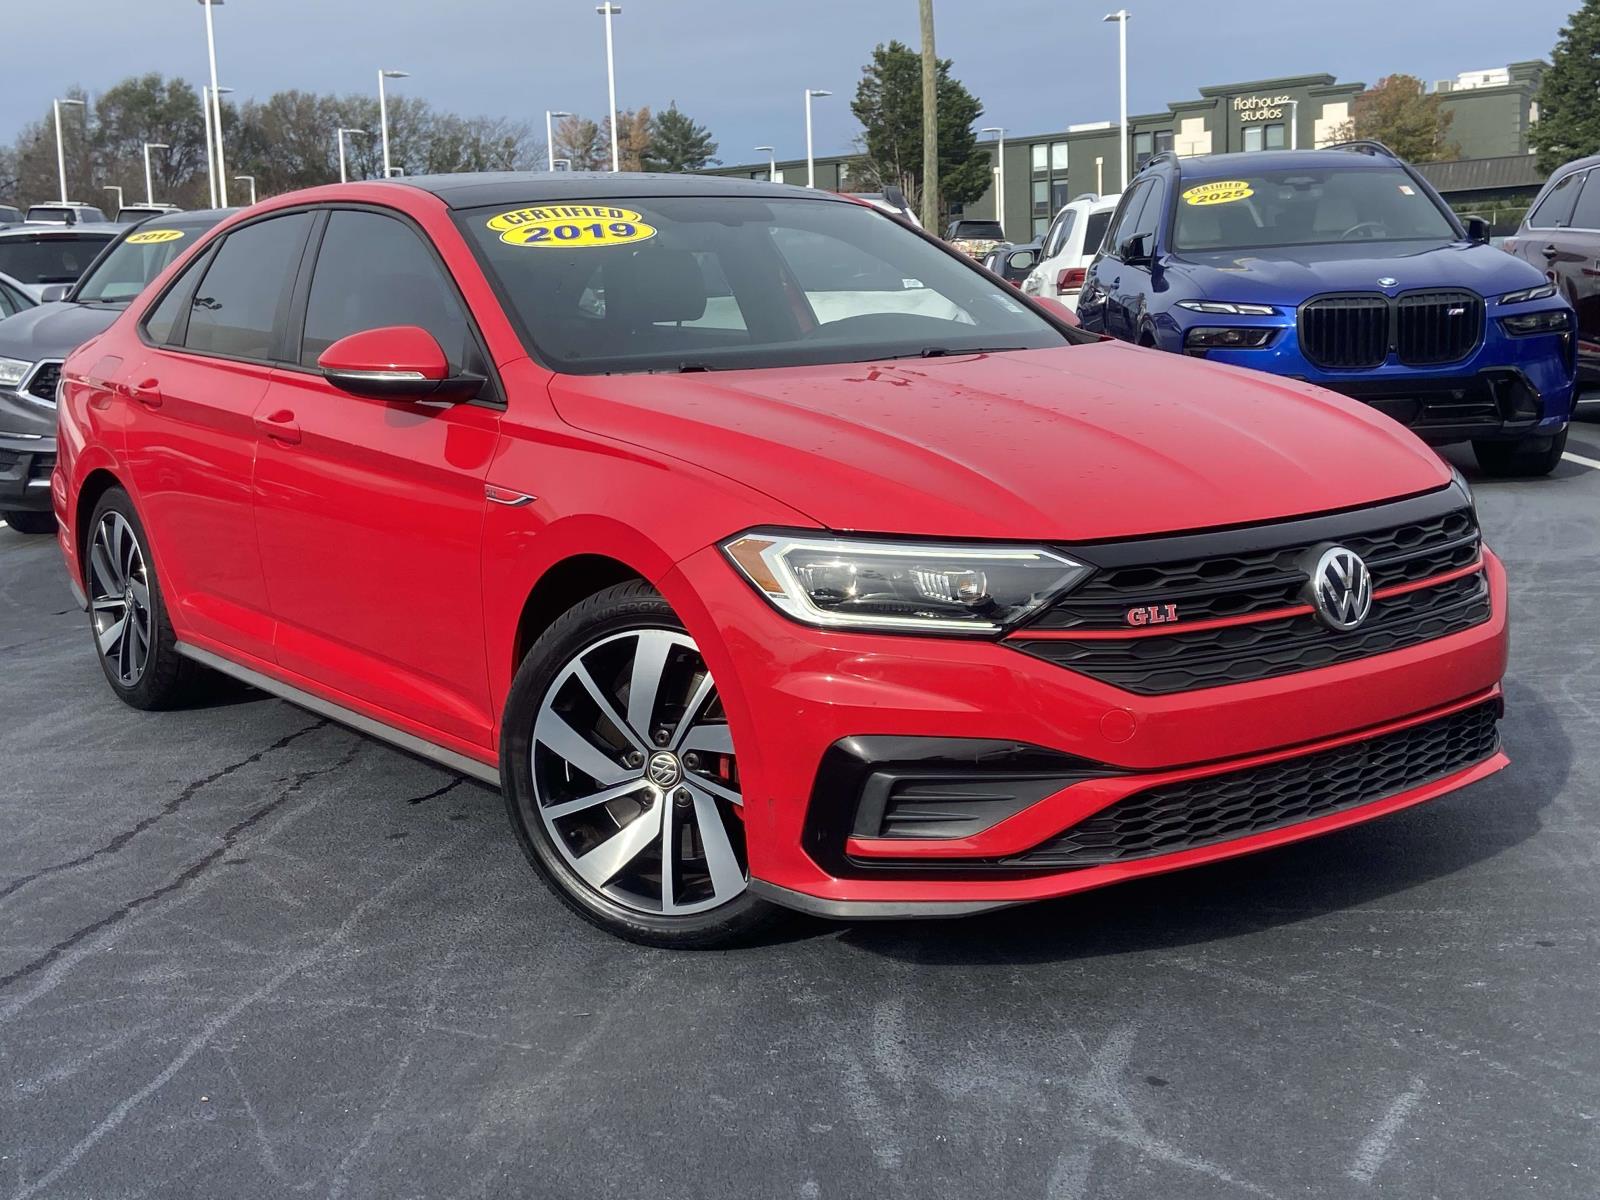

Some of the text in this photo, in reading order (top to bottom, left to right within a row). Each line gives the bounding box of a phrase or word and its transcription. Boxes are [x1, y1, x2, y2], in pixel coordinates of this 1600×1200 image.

[1241, 108, 1283, 121] studios
[1190, 182, 1241, 195] CERTIFIED
[1196, 190, 1245, 203] 2025
[502, 207, 624, 225] CERTIFIED
[131, 232, 179, 242] 2017
[523, 222, 637, 244] 2019
[1127, 604, 1178, 626] GLI
